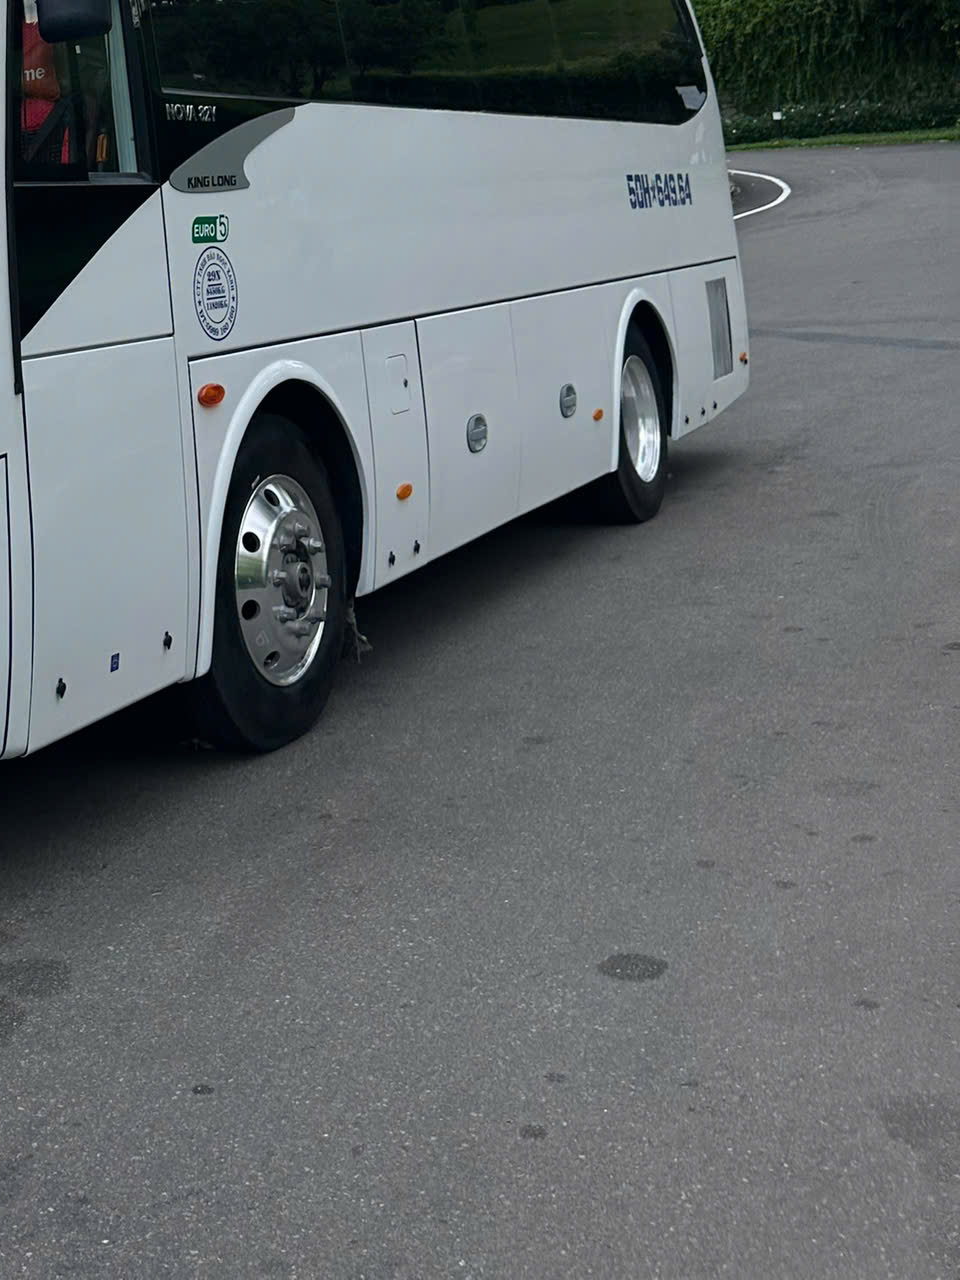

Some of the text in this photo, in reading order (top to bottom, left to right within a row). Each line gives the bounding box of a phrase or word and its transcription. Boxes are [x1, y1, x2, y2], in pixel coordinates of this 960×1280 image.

[165, 103, 197, 122] NOVA
[187, 175, 237, 189] KING LONG
[193, 214, 227, 237] EURO 5
